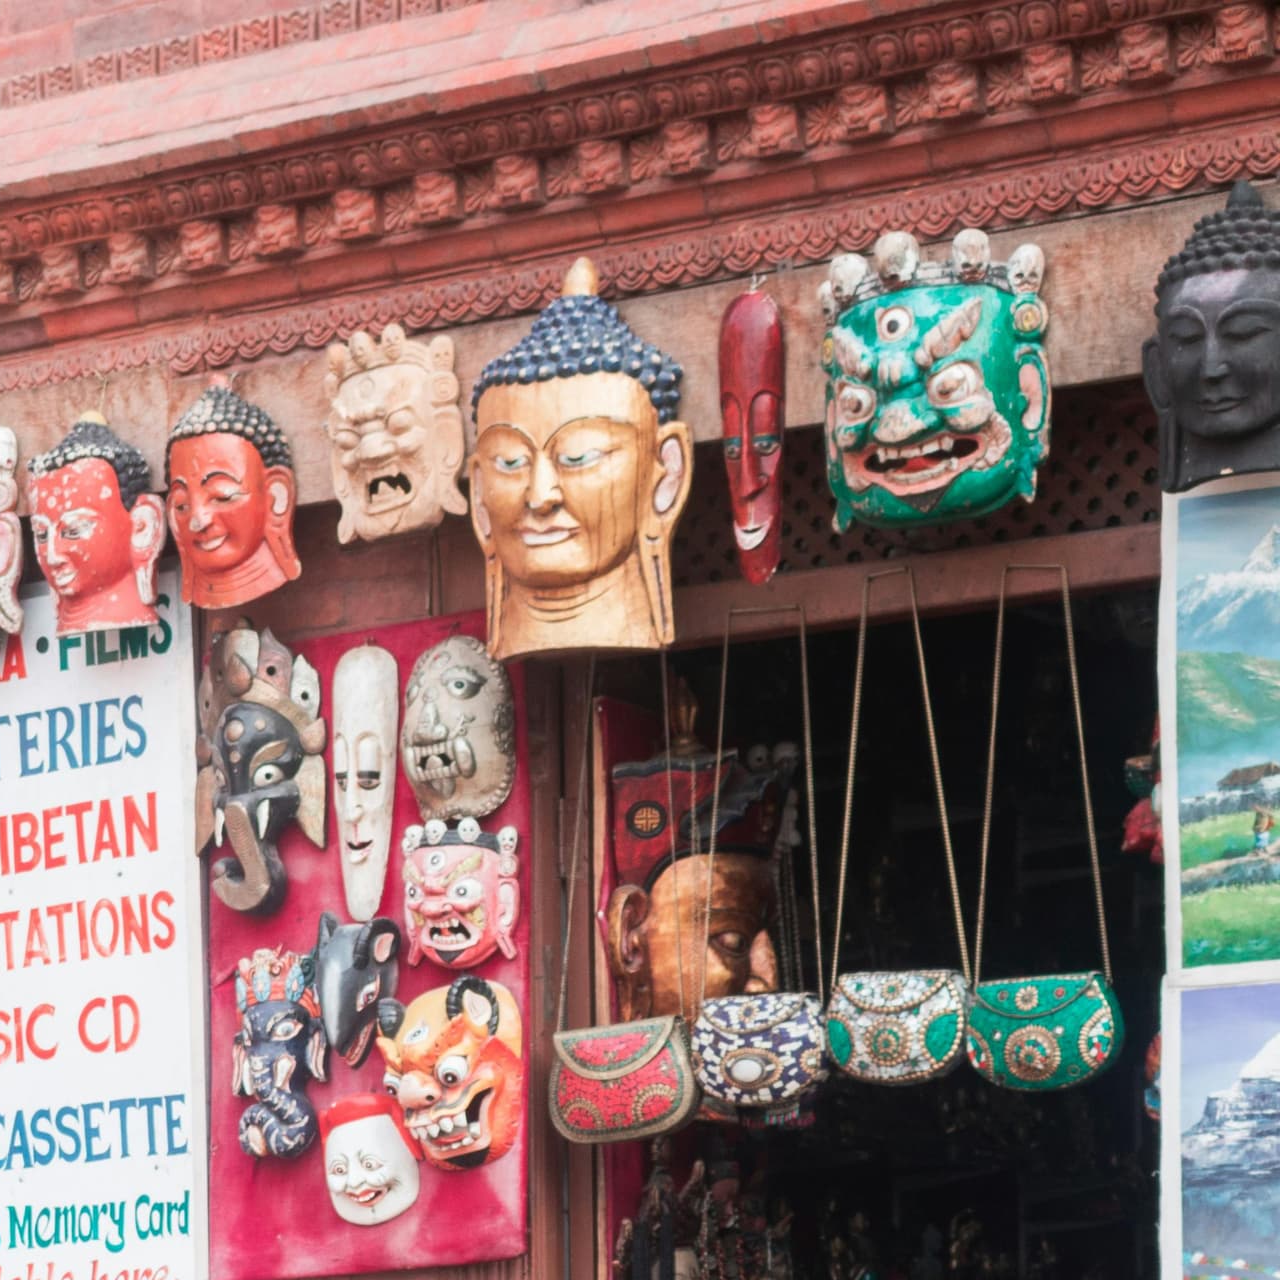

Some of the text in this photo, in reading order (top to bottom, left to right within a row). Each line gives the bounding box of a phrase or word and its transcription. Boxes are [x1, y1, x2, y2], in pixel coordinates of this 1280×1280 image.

[58, 593, 173, 671] FILMS
[78, 994, 141, 1053] CD
[7, 1200, 127, 1253] Memory
[134, 1190, 190, 1240] Card
